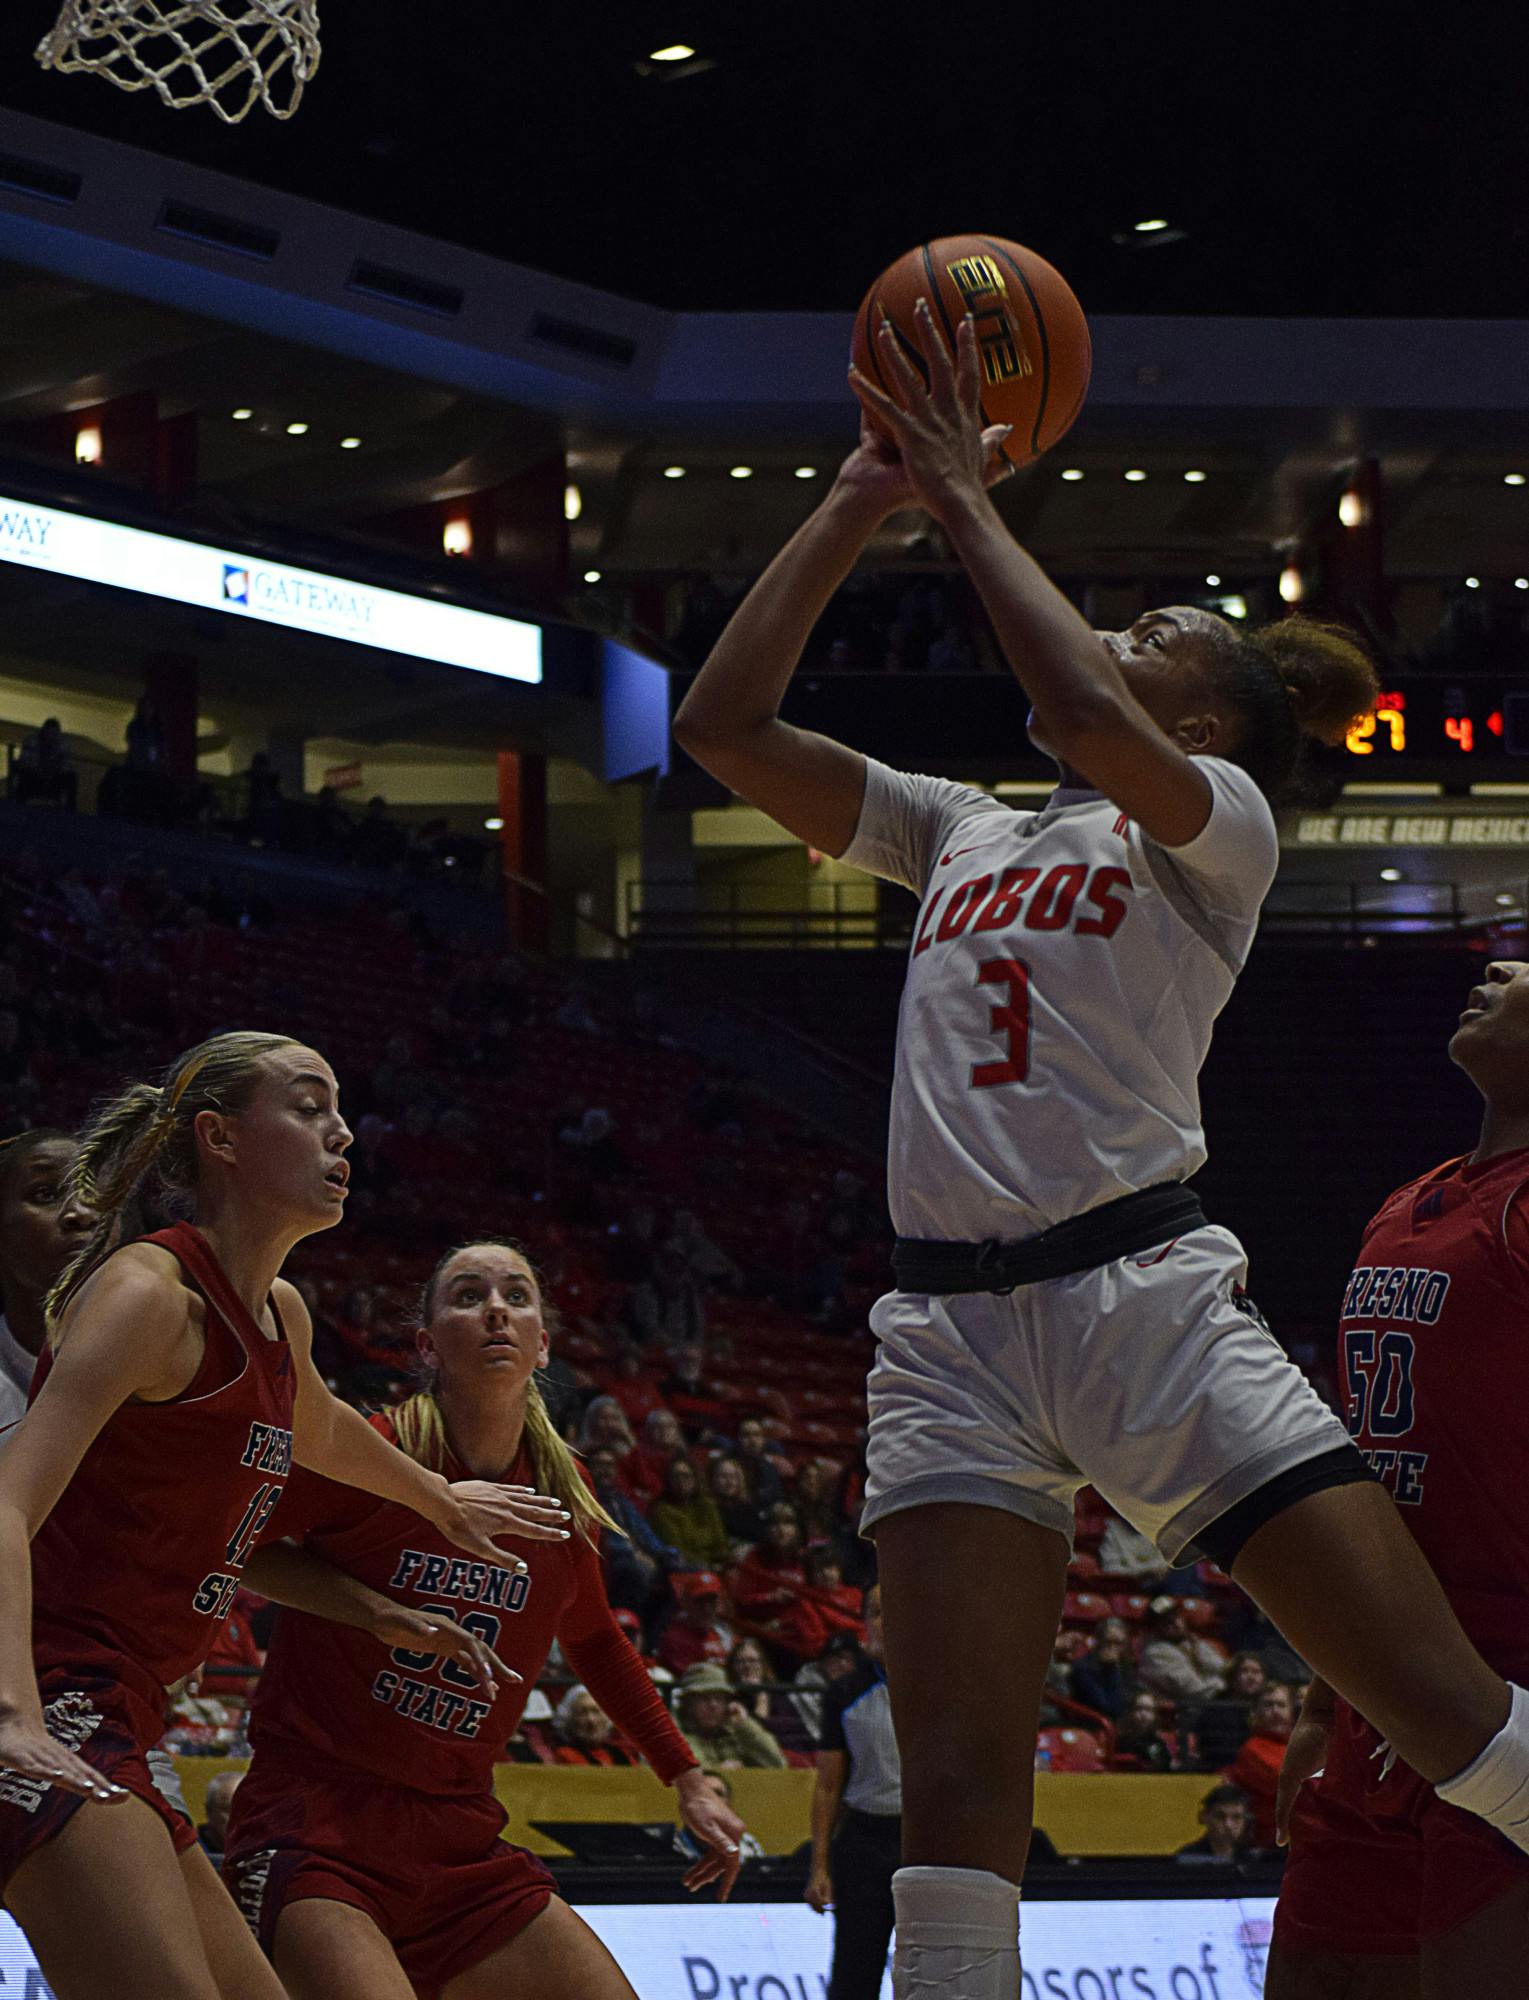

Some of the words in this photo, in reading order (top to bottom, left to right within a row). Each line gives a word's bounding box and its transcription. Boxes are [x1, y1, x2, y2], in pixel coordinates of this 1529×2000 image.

[255, 571, 376, 622] GATEWAY
[1346, 709, 1406, 754] 27
[1445, 717, 1473, 751] 4
[1298, 816, 1339, 843] WE
[1340, 816, 1391, 843] ARE
[1392, 816, 1449, 844] NEW
[913, 863, 1134, 960] LOBOS
[970, 956, 1032, 1091] 3
[1342, 1266, 1451, 1326] RESNO
[1345, 1329, 1416, 1439] 50
[388, 1548, 532, 1613] FRESNO
[370, 1669, 492, 1739] STATE
